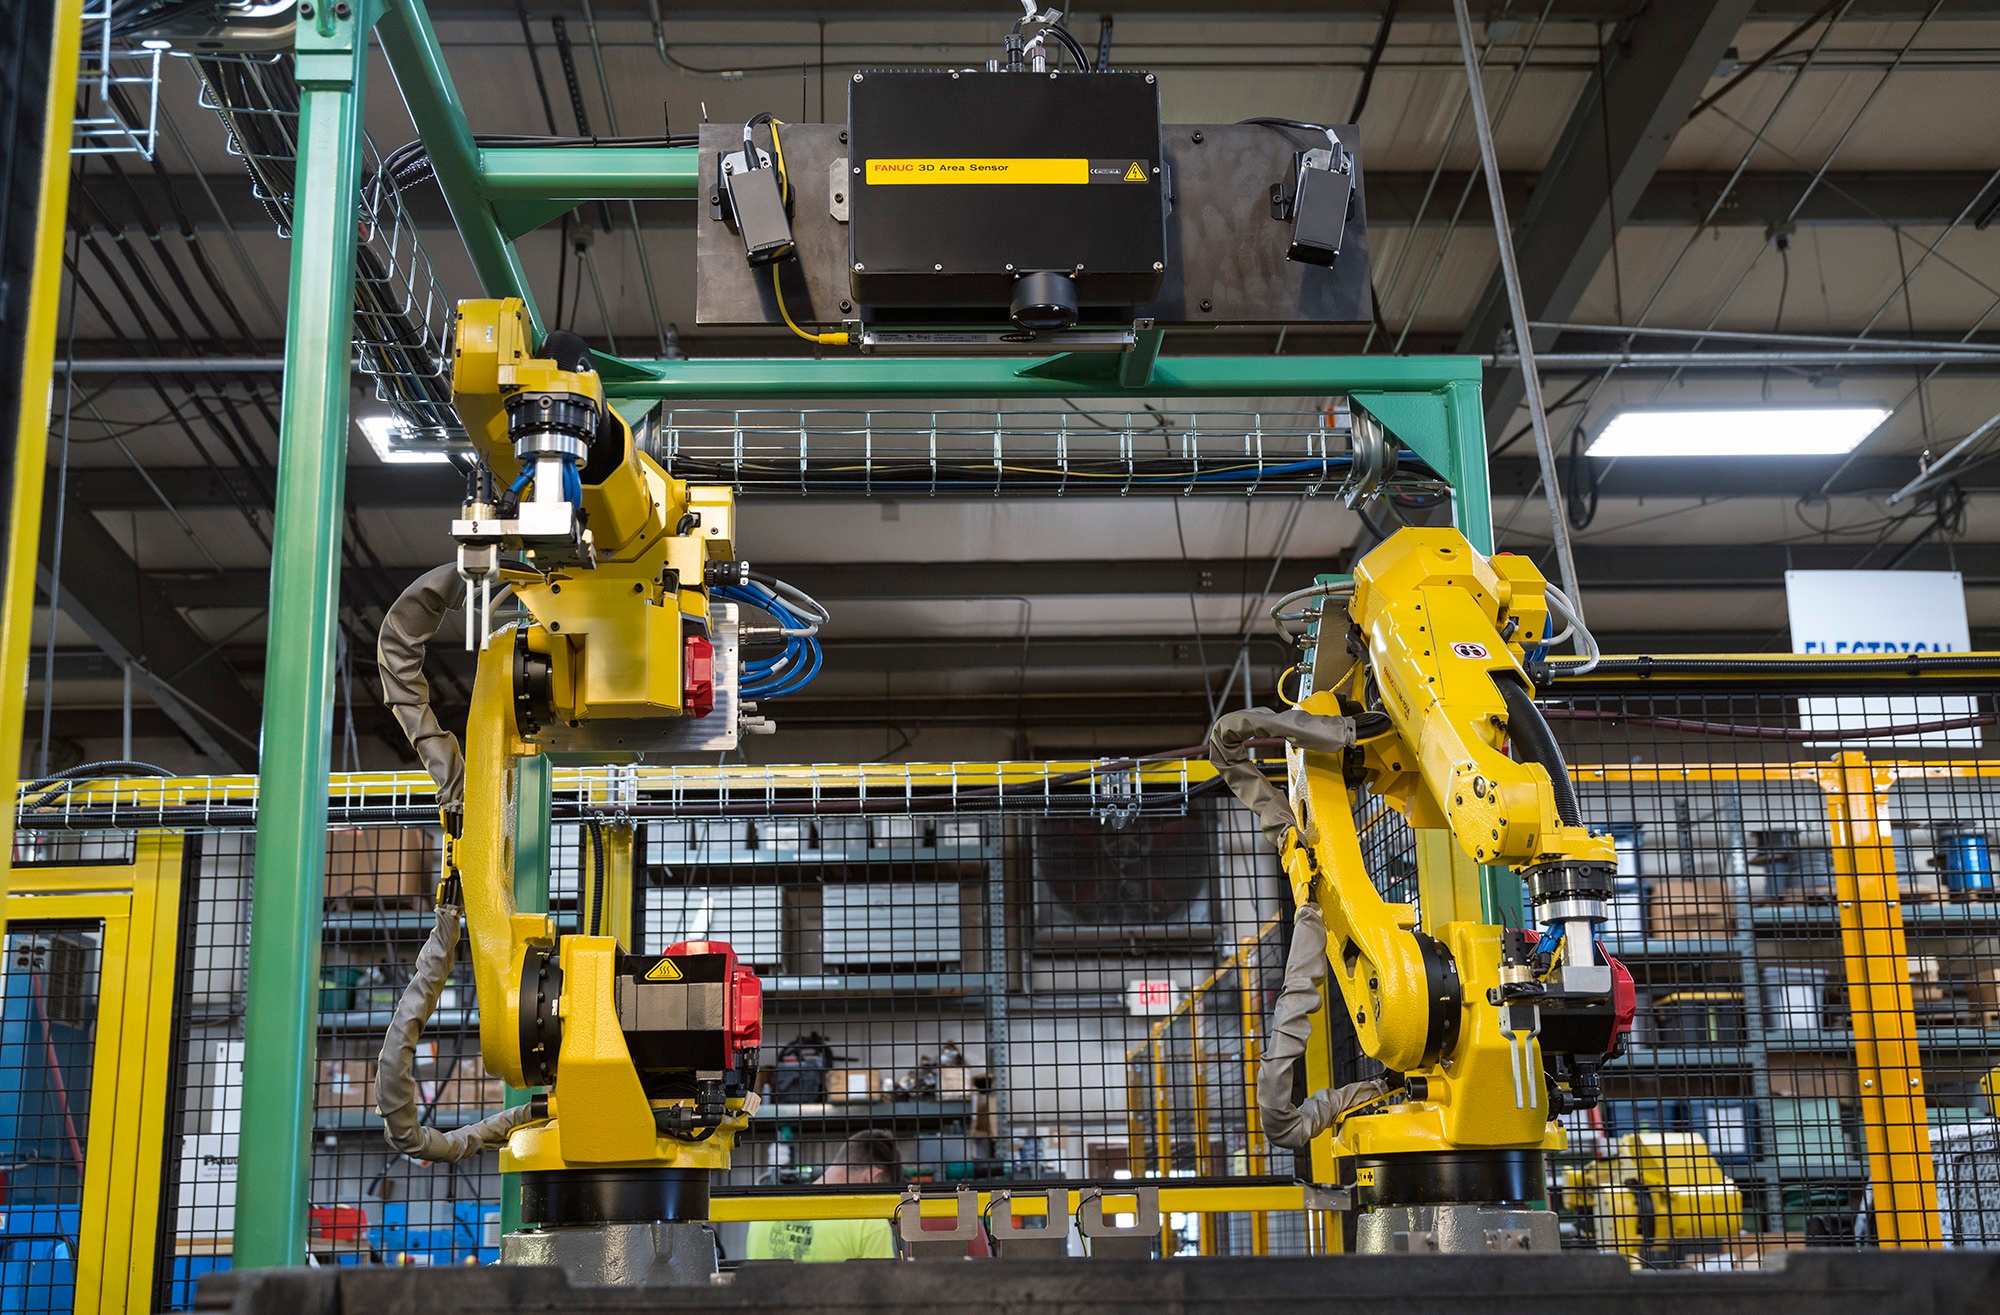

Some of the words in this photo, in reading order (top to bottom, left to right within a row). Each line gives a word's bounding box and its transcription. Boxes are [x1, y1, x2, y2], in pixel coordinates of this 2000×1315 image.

[874, 163, 914, 172] FANUC
[918, 163, 935, 171] 3D
[939, 163, 965, 171] Area
[969, 163, 1009, 171] Sensor
[1139, 982, 1169, 1005] EXIT
